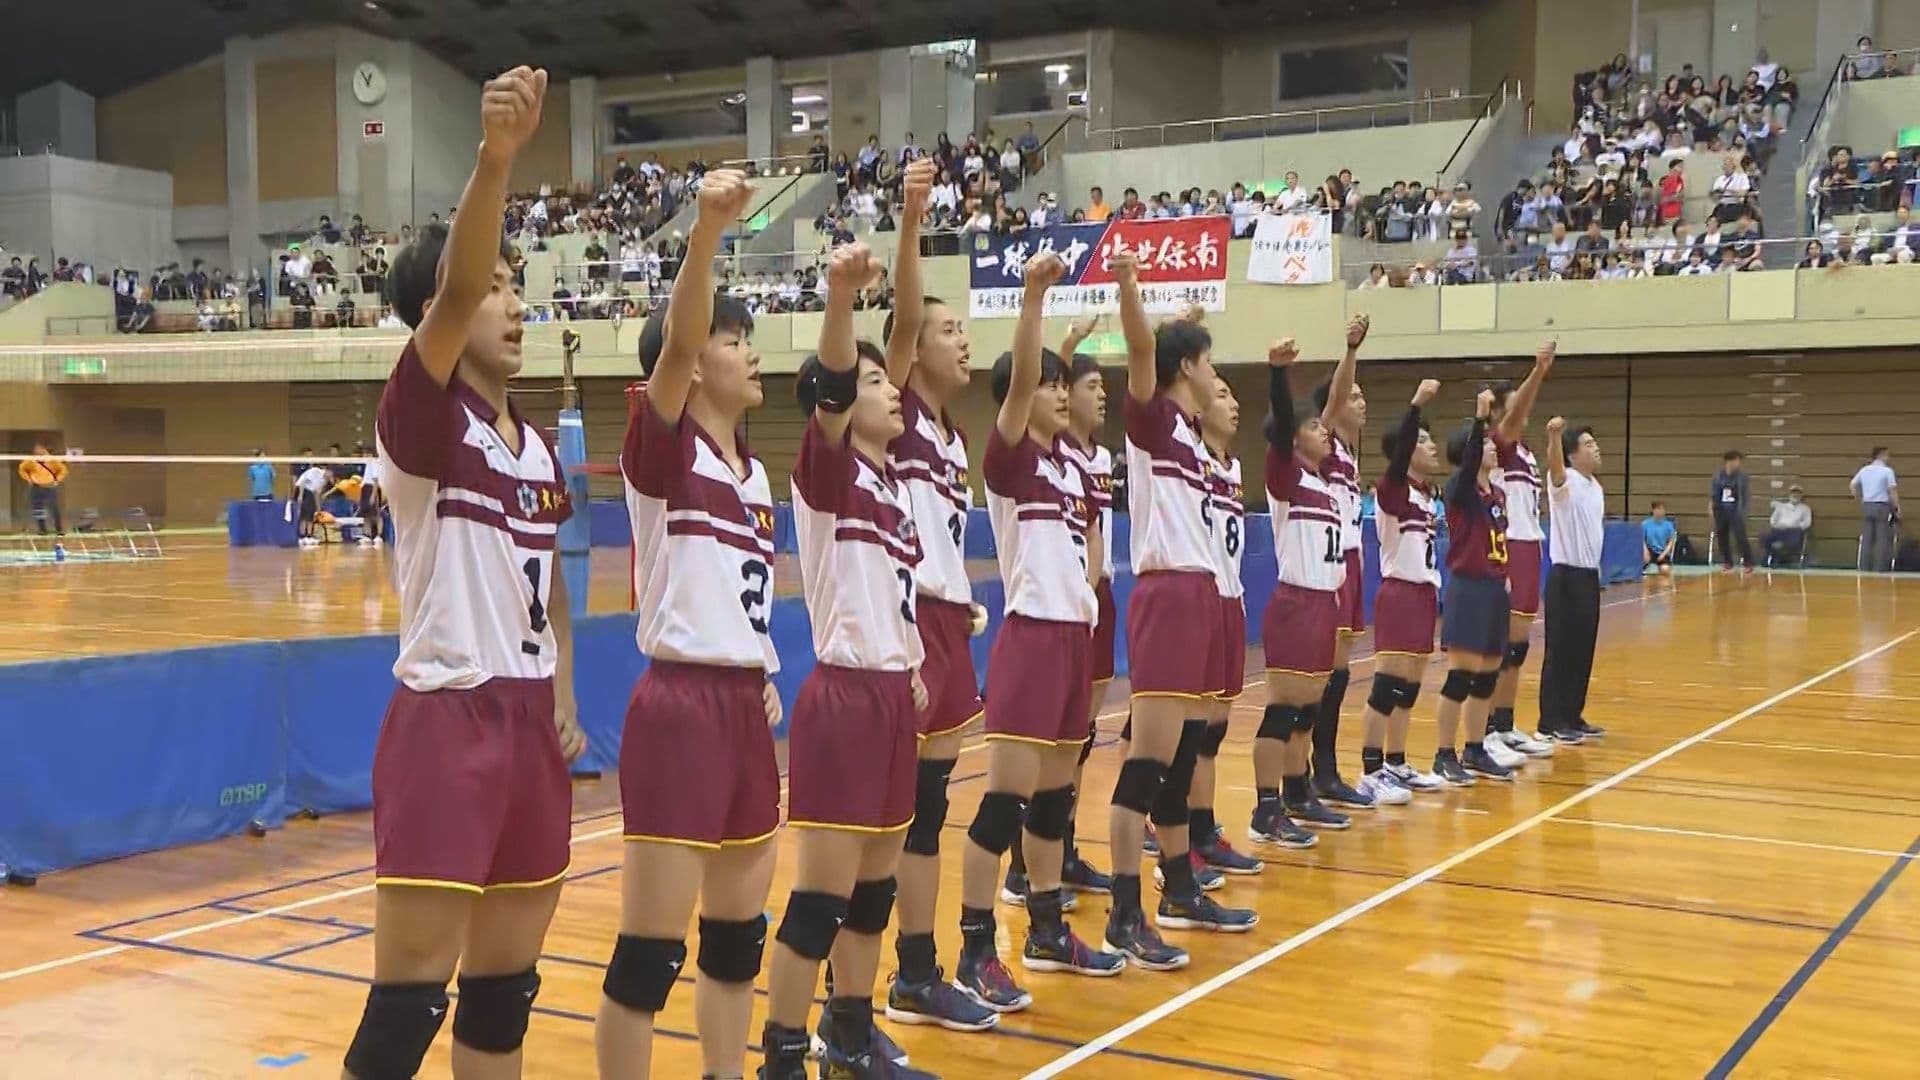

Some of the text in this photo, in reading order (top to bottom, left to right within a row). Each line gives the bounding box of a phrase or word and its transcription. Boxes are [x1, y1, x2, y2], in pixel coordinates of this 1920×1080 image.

[1226, 515, 1240, 558] 8
[523, 556, 548, 634] 1
[740, 559, 769, 635] 2
